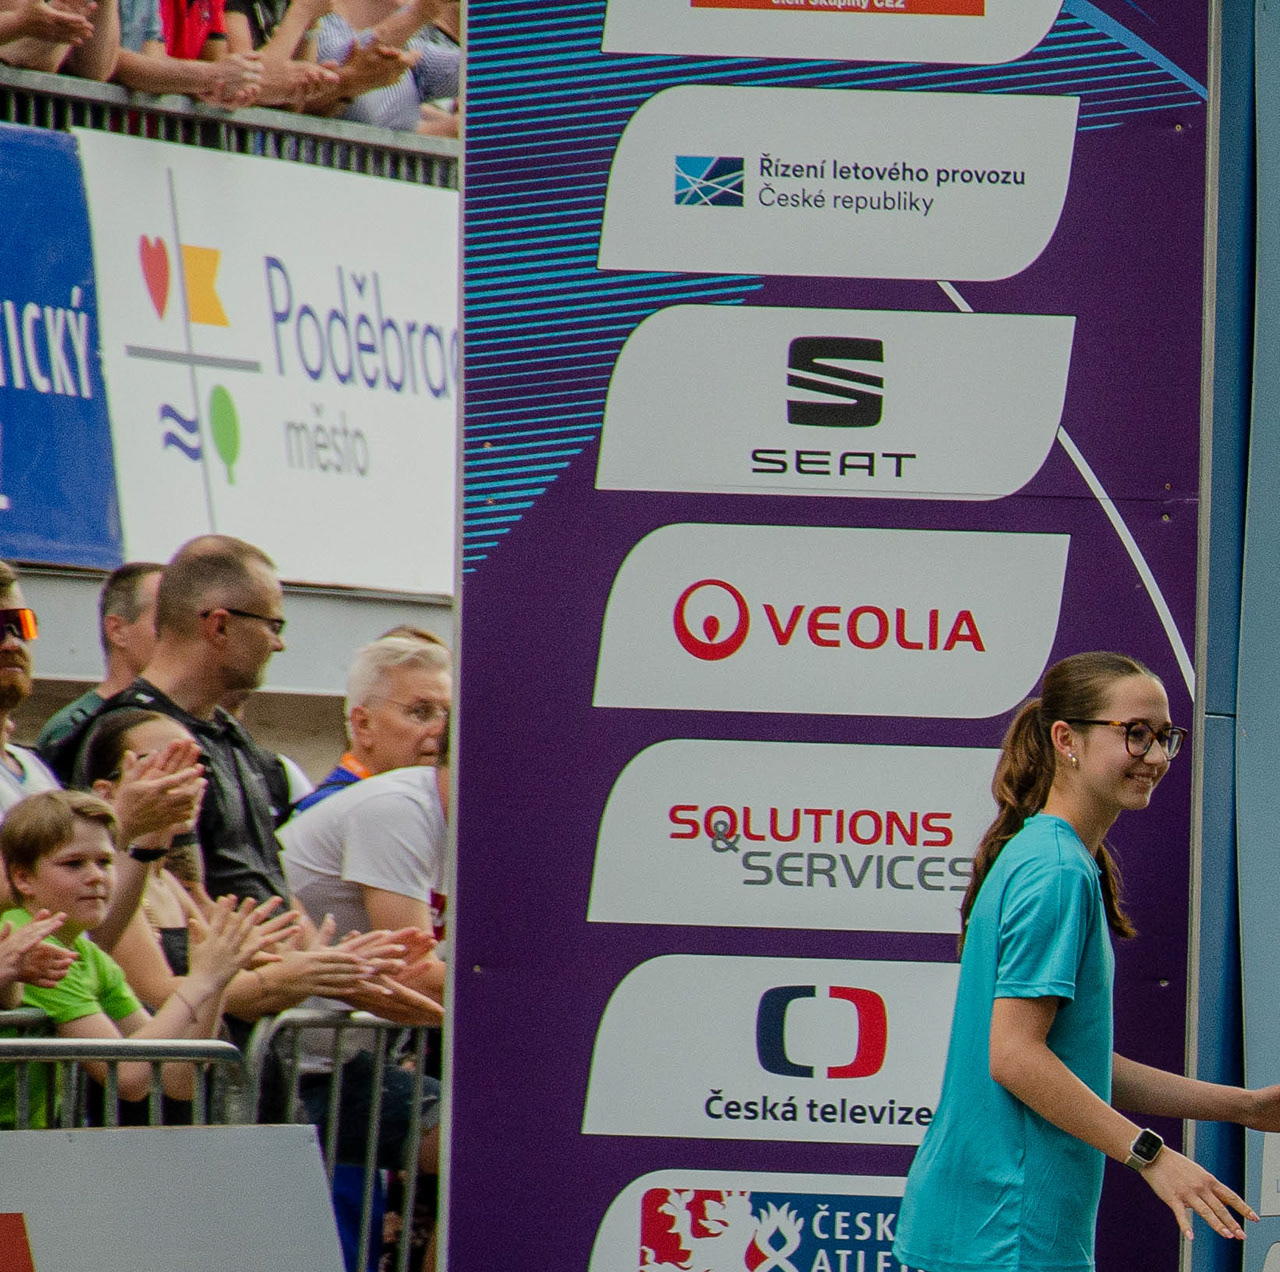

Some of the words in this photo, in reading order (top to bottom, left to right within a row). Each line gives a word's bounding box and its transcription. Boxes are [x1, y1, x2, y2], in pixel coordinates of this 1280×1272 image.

[759, 153, 825, 179] Řízení
[832, 160, 930, 183] letového
[935, 167, 1026, 188] provozu
[758, 182, 826, 208] České
[833, 191, 934, 216] republiky
[0, 284, 93, 400] ICKÝ
[284, 401, 370, 477] město
[750, 448, 917, 479] SEAT
[762, 603, 987, 653] VEOLIA
[668, 804, 954, 848] SOLUTIONS
[740, 851, 973, 893] SERVICES
[705, 1088, 798, 1122] Česká
[807, 1098, 934, 1126] televize
